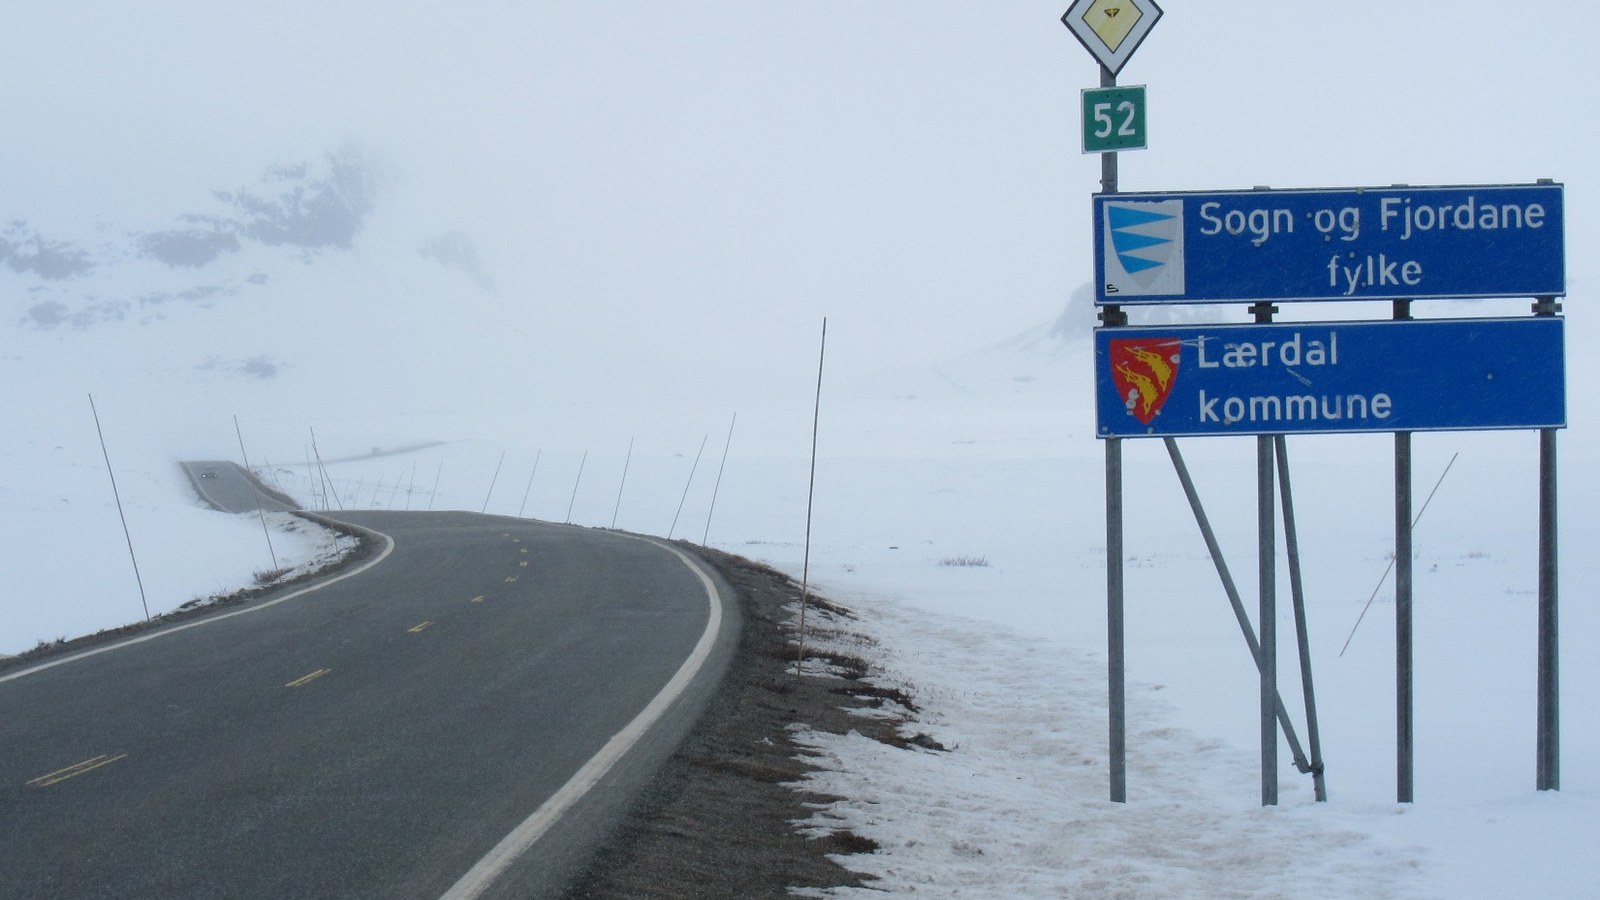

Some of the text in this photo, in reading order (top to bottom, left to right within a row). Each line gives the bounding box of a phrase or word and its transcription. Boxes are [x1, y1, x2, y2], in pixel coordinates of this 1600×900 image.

[1094, 101, 1136, 138] 52
[1199, 196, 1546, 245] Sogn og Fjordane
[1327, 253, 1422, 296] fylke
[1198, 331, 1339, 368] Lærdal
[1199, 389, 1392, 423] kommune
